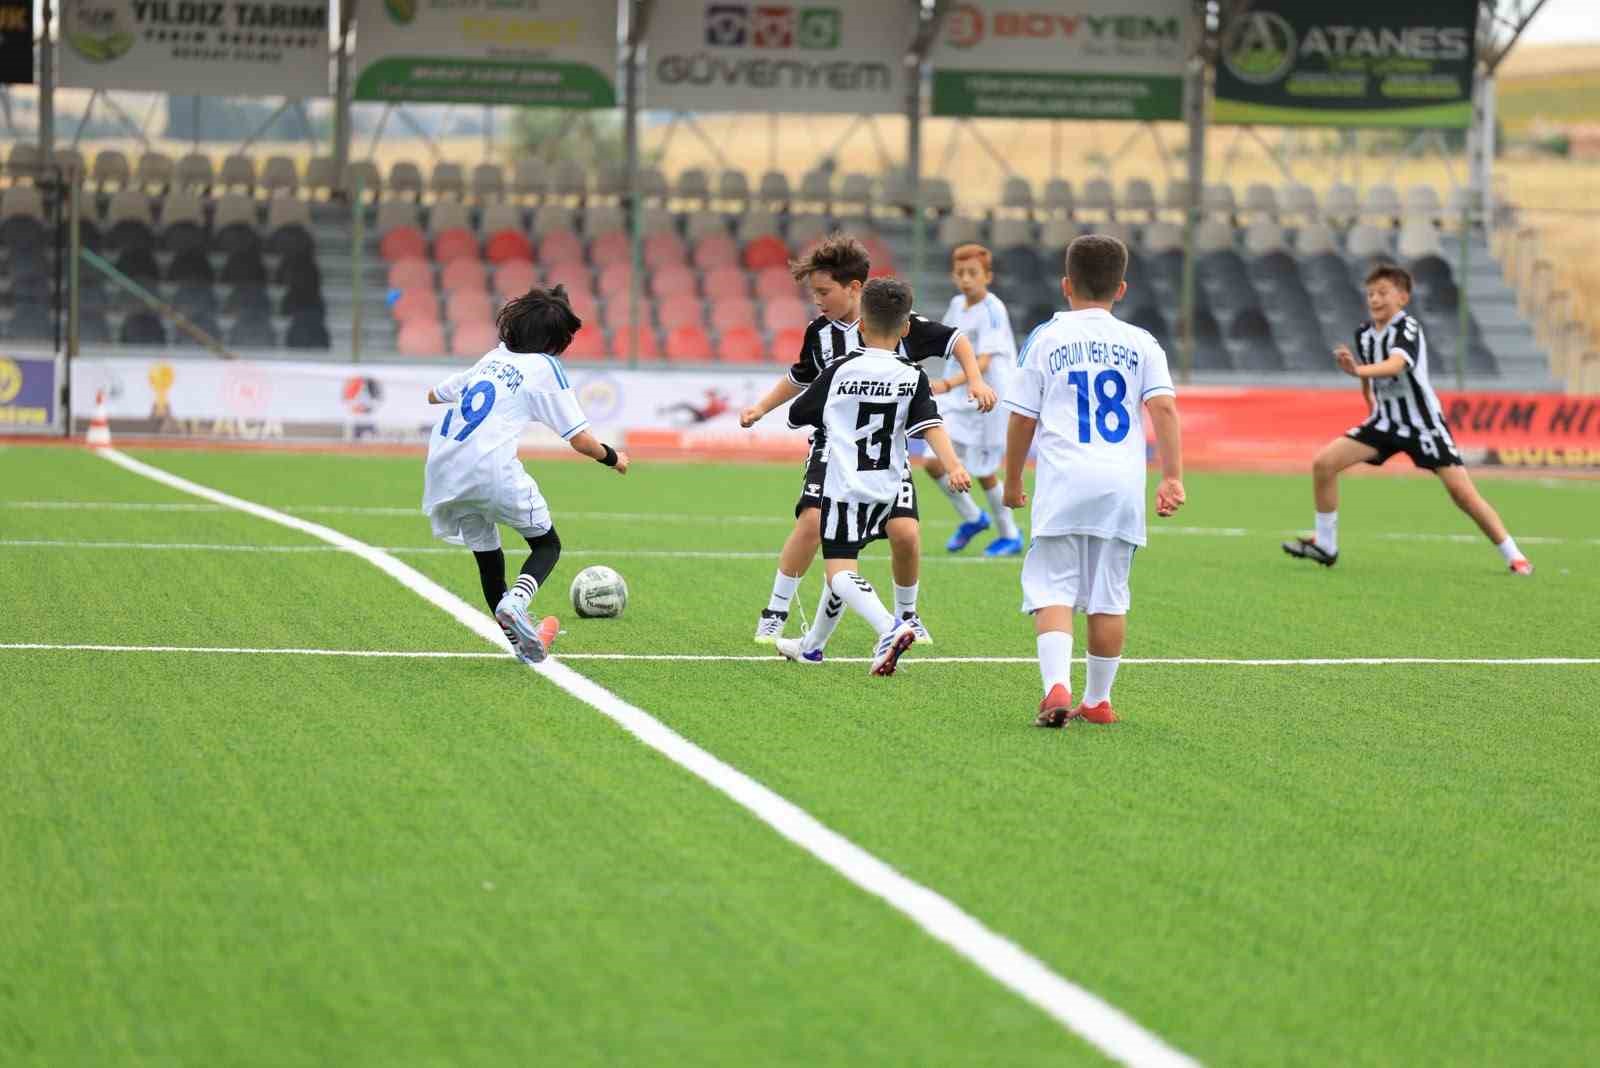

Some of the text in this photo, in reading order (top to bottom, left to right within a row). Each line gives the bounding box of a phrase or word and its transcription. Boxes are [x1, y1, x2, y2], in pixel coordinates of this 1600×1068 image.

[132, 1, 223, 26] YILDIZ
[236, 3, 328, 28] TARIM
[1300, 25, 1469, 60] ATANES
[1111, 343, 1139, 376] SPOR
[836, 381, 917, 397] KARTAL SK
[1067, 369, 1130, 444] 18
[440, 380, 496, 442] 19
[855, 401, 899, 472] 3
